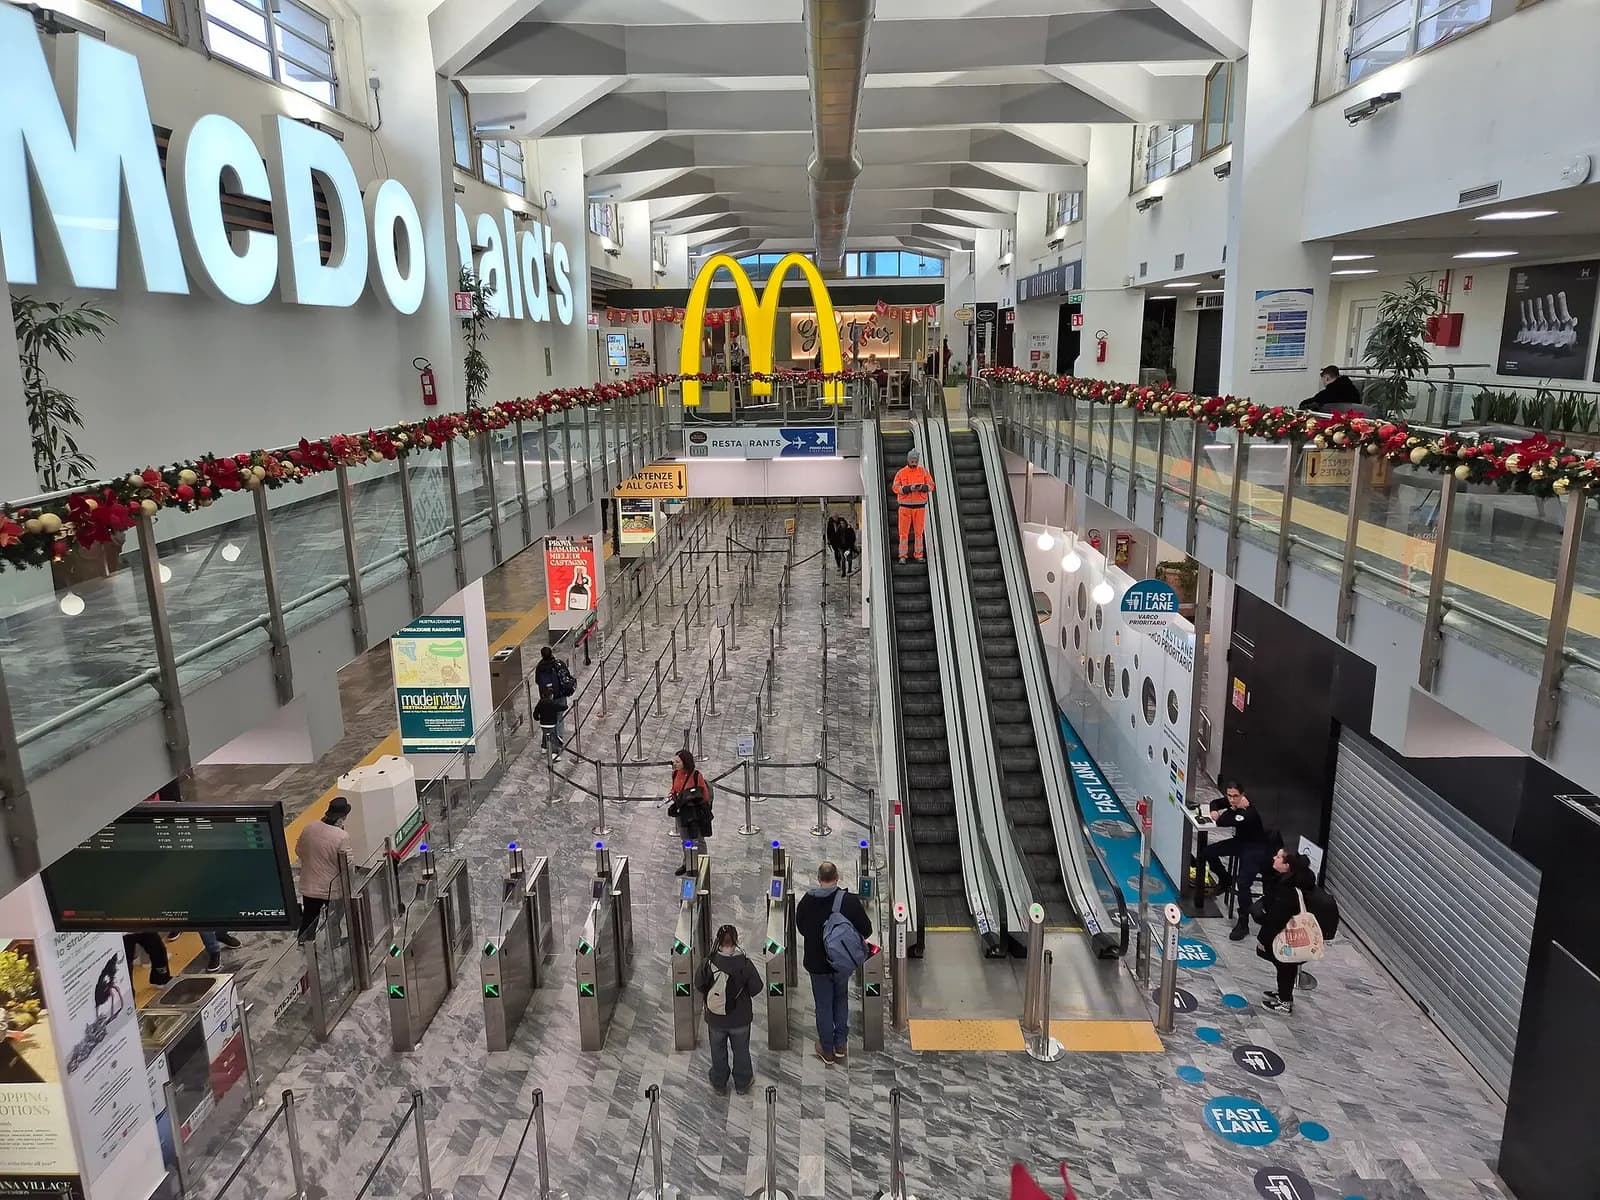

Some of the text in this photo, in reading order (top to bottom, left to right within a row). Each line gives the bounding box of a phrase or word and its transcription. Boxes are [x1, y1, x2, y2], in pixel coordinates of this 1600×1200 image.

[712, 439, 781, 448] RESTARANTS
[628, 472, 673, 481] ARTENZE
[626, 481, 674, 490] ALL GATES
[1146, 592, 1174, 602] FAST
[1145, 601, 1174, 611] LANE
[1070, 761, 1102, 786] LANE
[1086, 787, 1120, 813] FAST
[1177, 944, 1203, 953] AST
[1177, 952, 1211, 961] ANE
[1211, 1108, 1262, 1121] FAST
[1216, 1120, 1273, 1133] LANE
